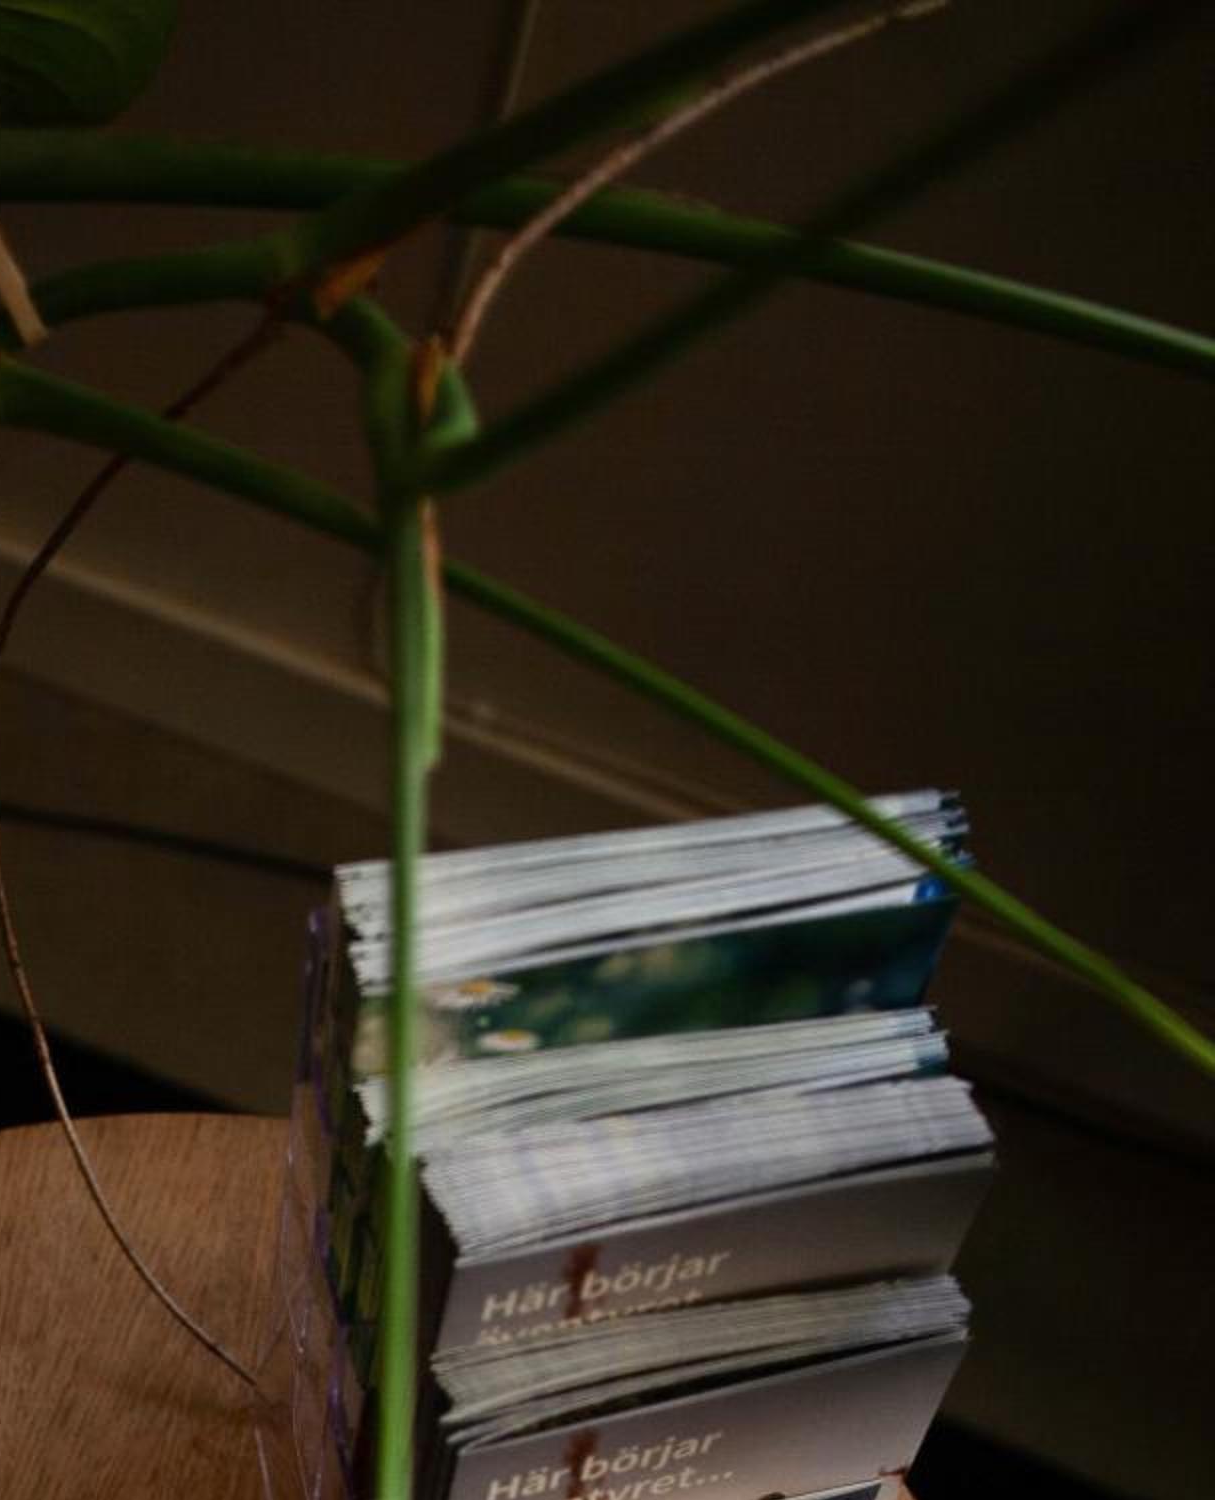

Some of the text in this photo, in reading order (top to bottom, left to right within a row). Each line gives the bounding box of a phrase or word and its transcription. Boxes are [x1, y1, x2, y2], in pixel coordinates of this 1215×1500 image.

[481, 1279, 573, 1322] Här
[579, 1250, 731, 1301] börjar
[580, 1430, 723, 1482] börjar
